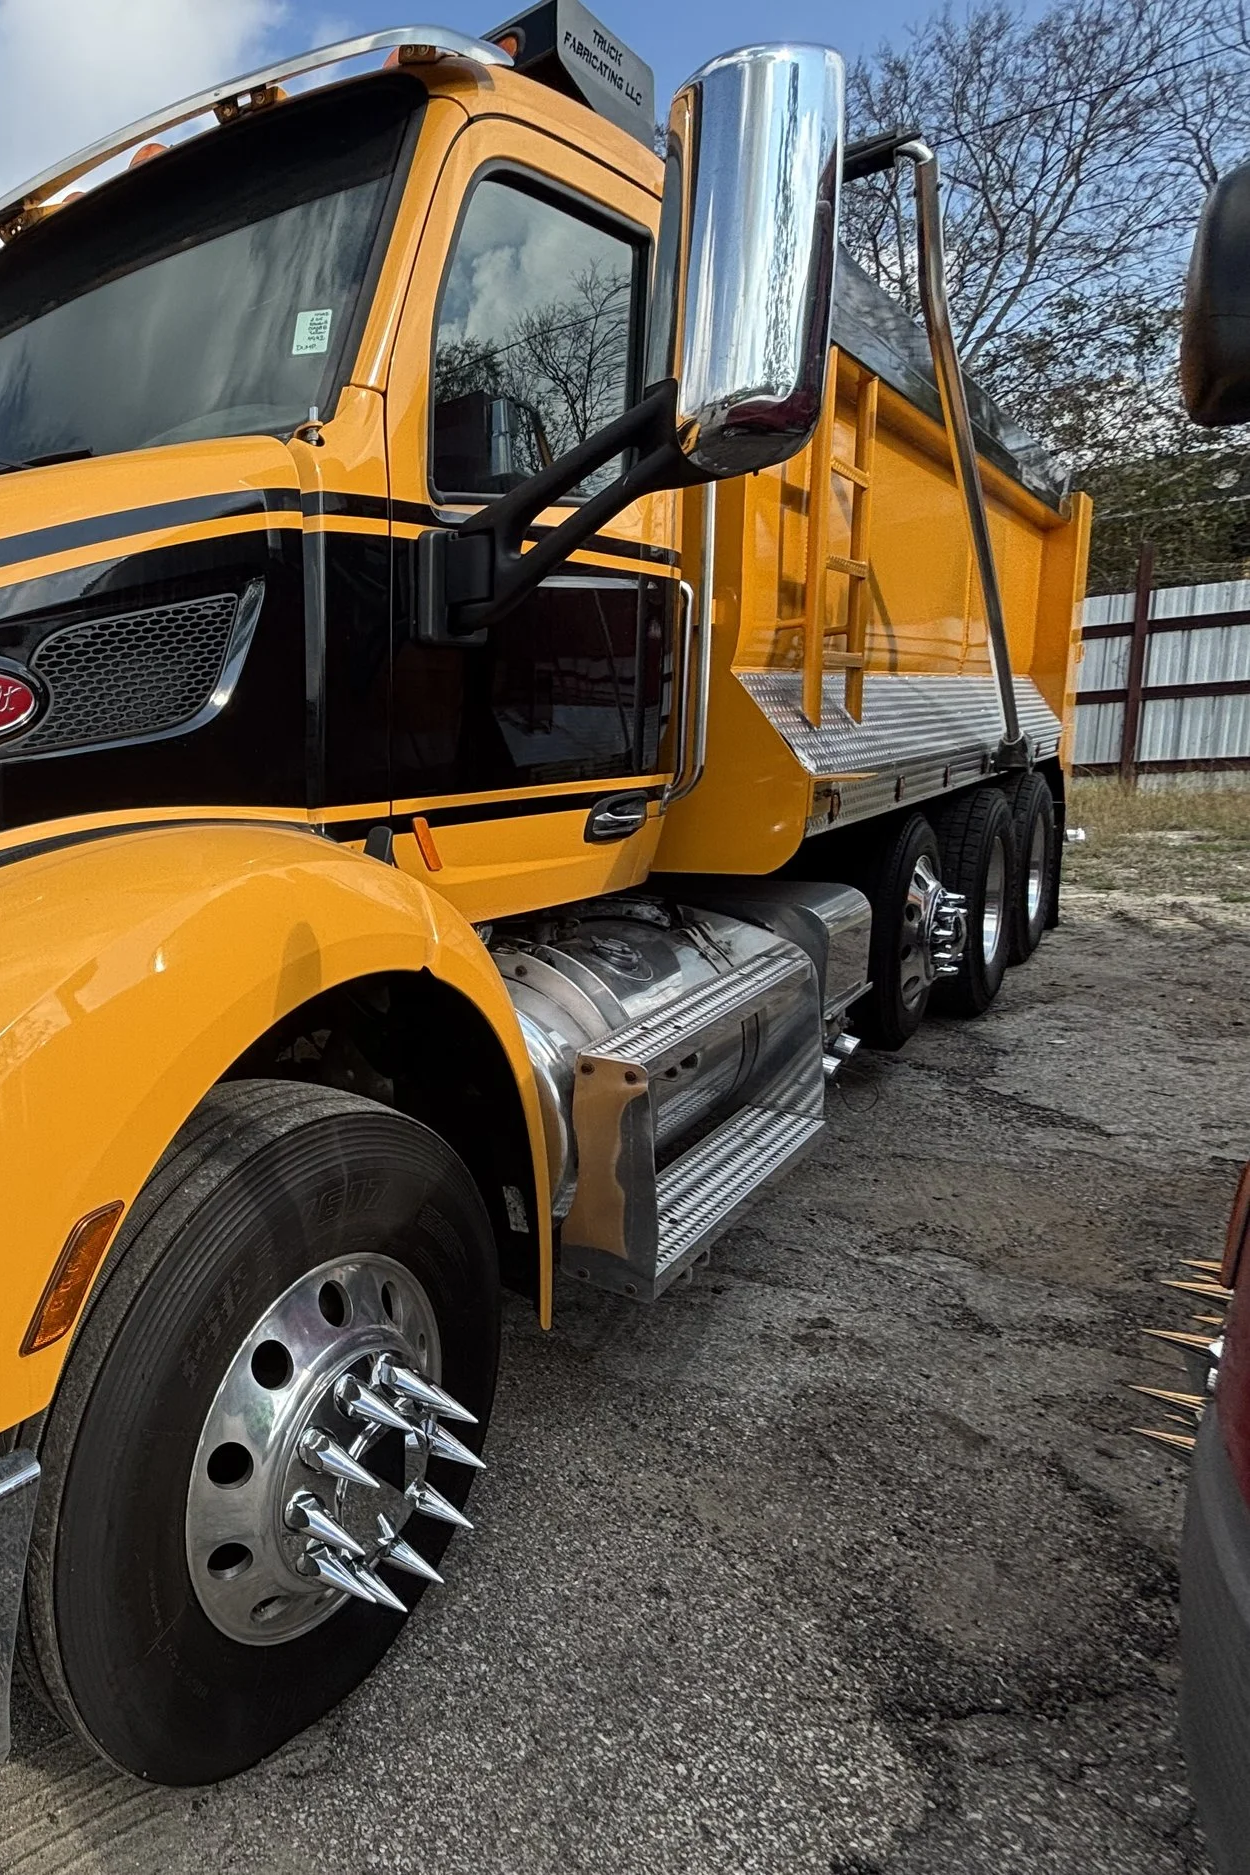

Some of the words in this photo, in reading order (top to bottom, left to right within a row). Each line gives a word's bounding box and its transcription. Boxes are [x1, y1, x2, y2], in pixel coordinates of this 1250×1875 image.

[563, 31, 624, 92] FABRICATING
[625, 82, 642, 106] LLC
[592, 29, 623, 66] TRUCK
